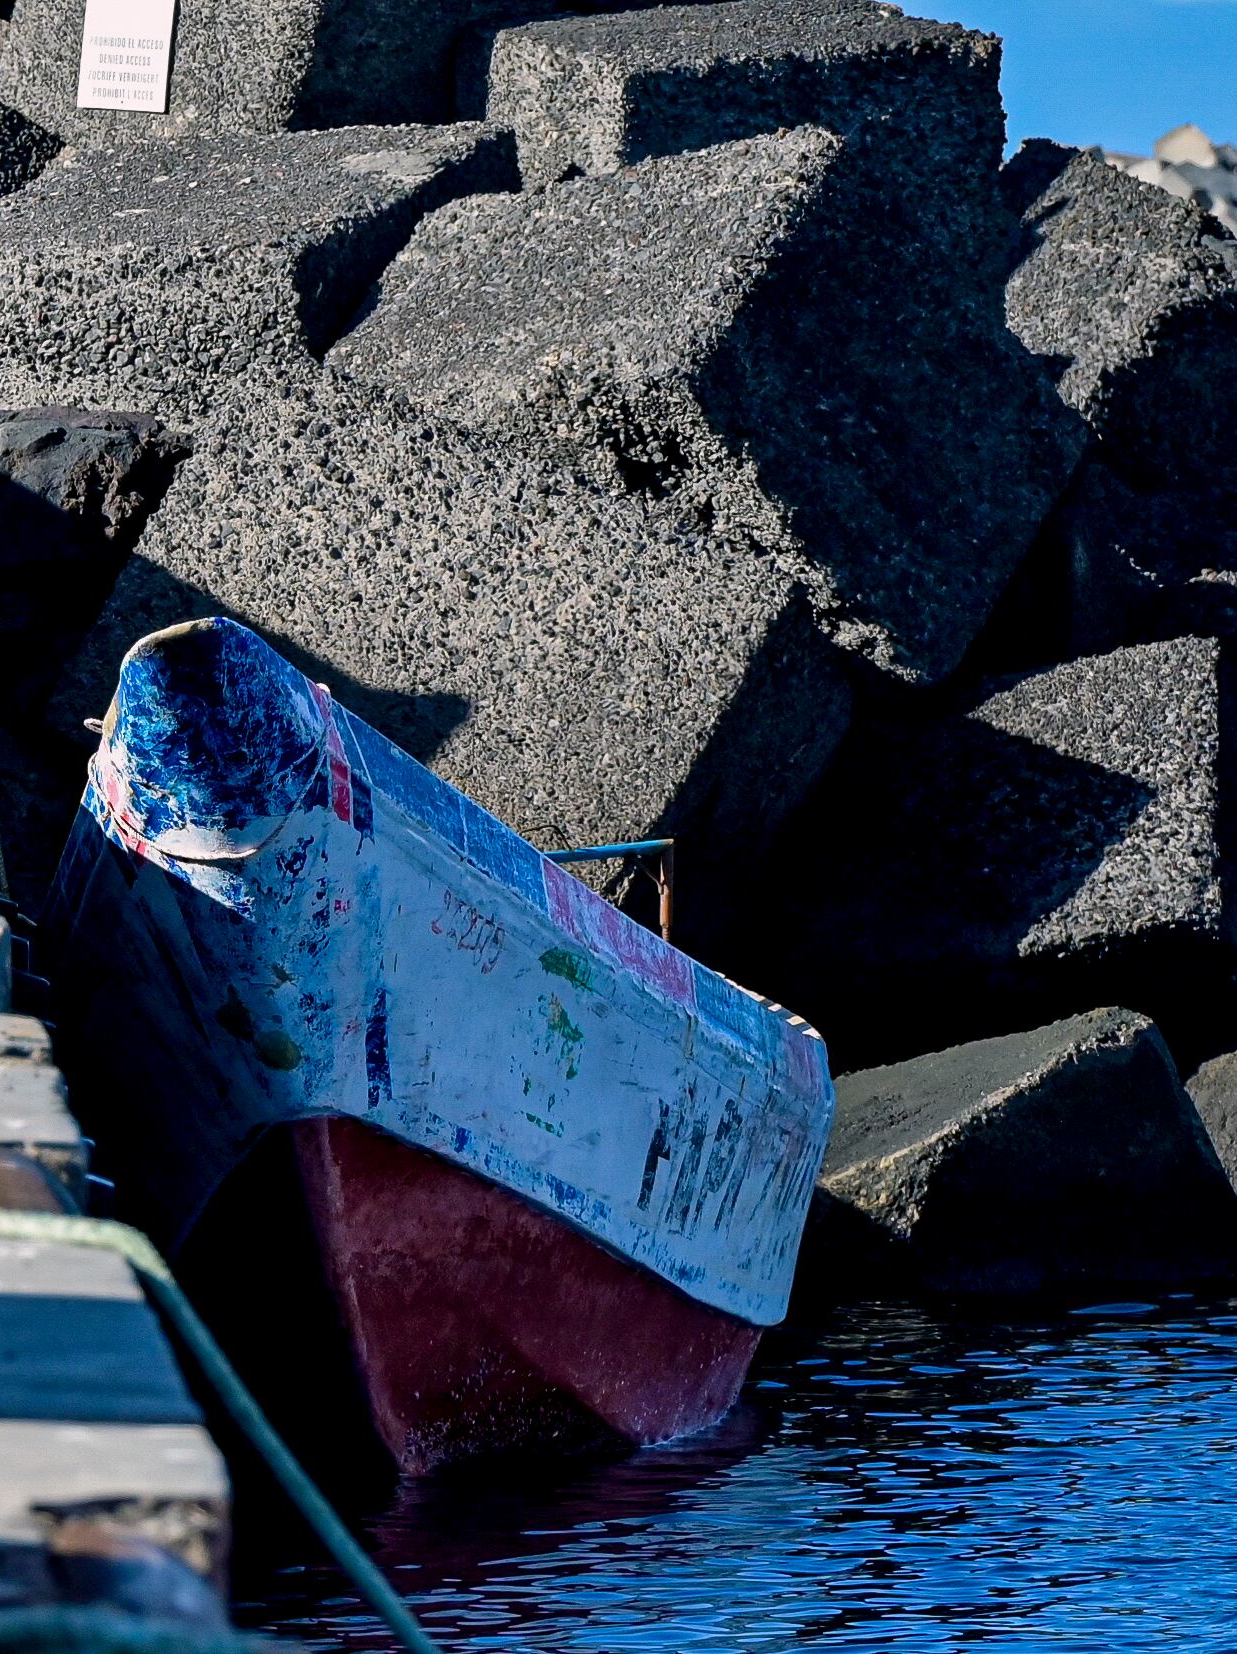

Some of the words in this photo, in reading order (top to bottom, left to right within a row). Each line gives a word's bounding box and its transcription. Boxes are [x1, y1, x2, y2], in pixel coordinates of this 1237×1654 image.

[89, 36, 126, 48] PROHIBIDO
[128, 38, 135, 49] EL
[137, 38, 164, 50] ACCESO
[99, 53, 124, 65] DENIED
[125, 55, 151, 66] ACCESS
[92, 87, 125, 98] PROHIBIT
